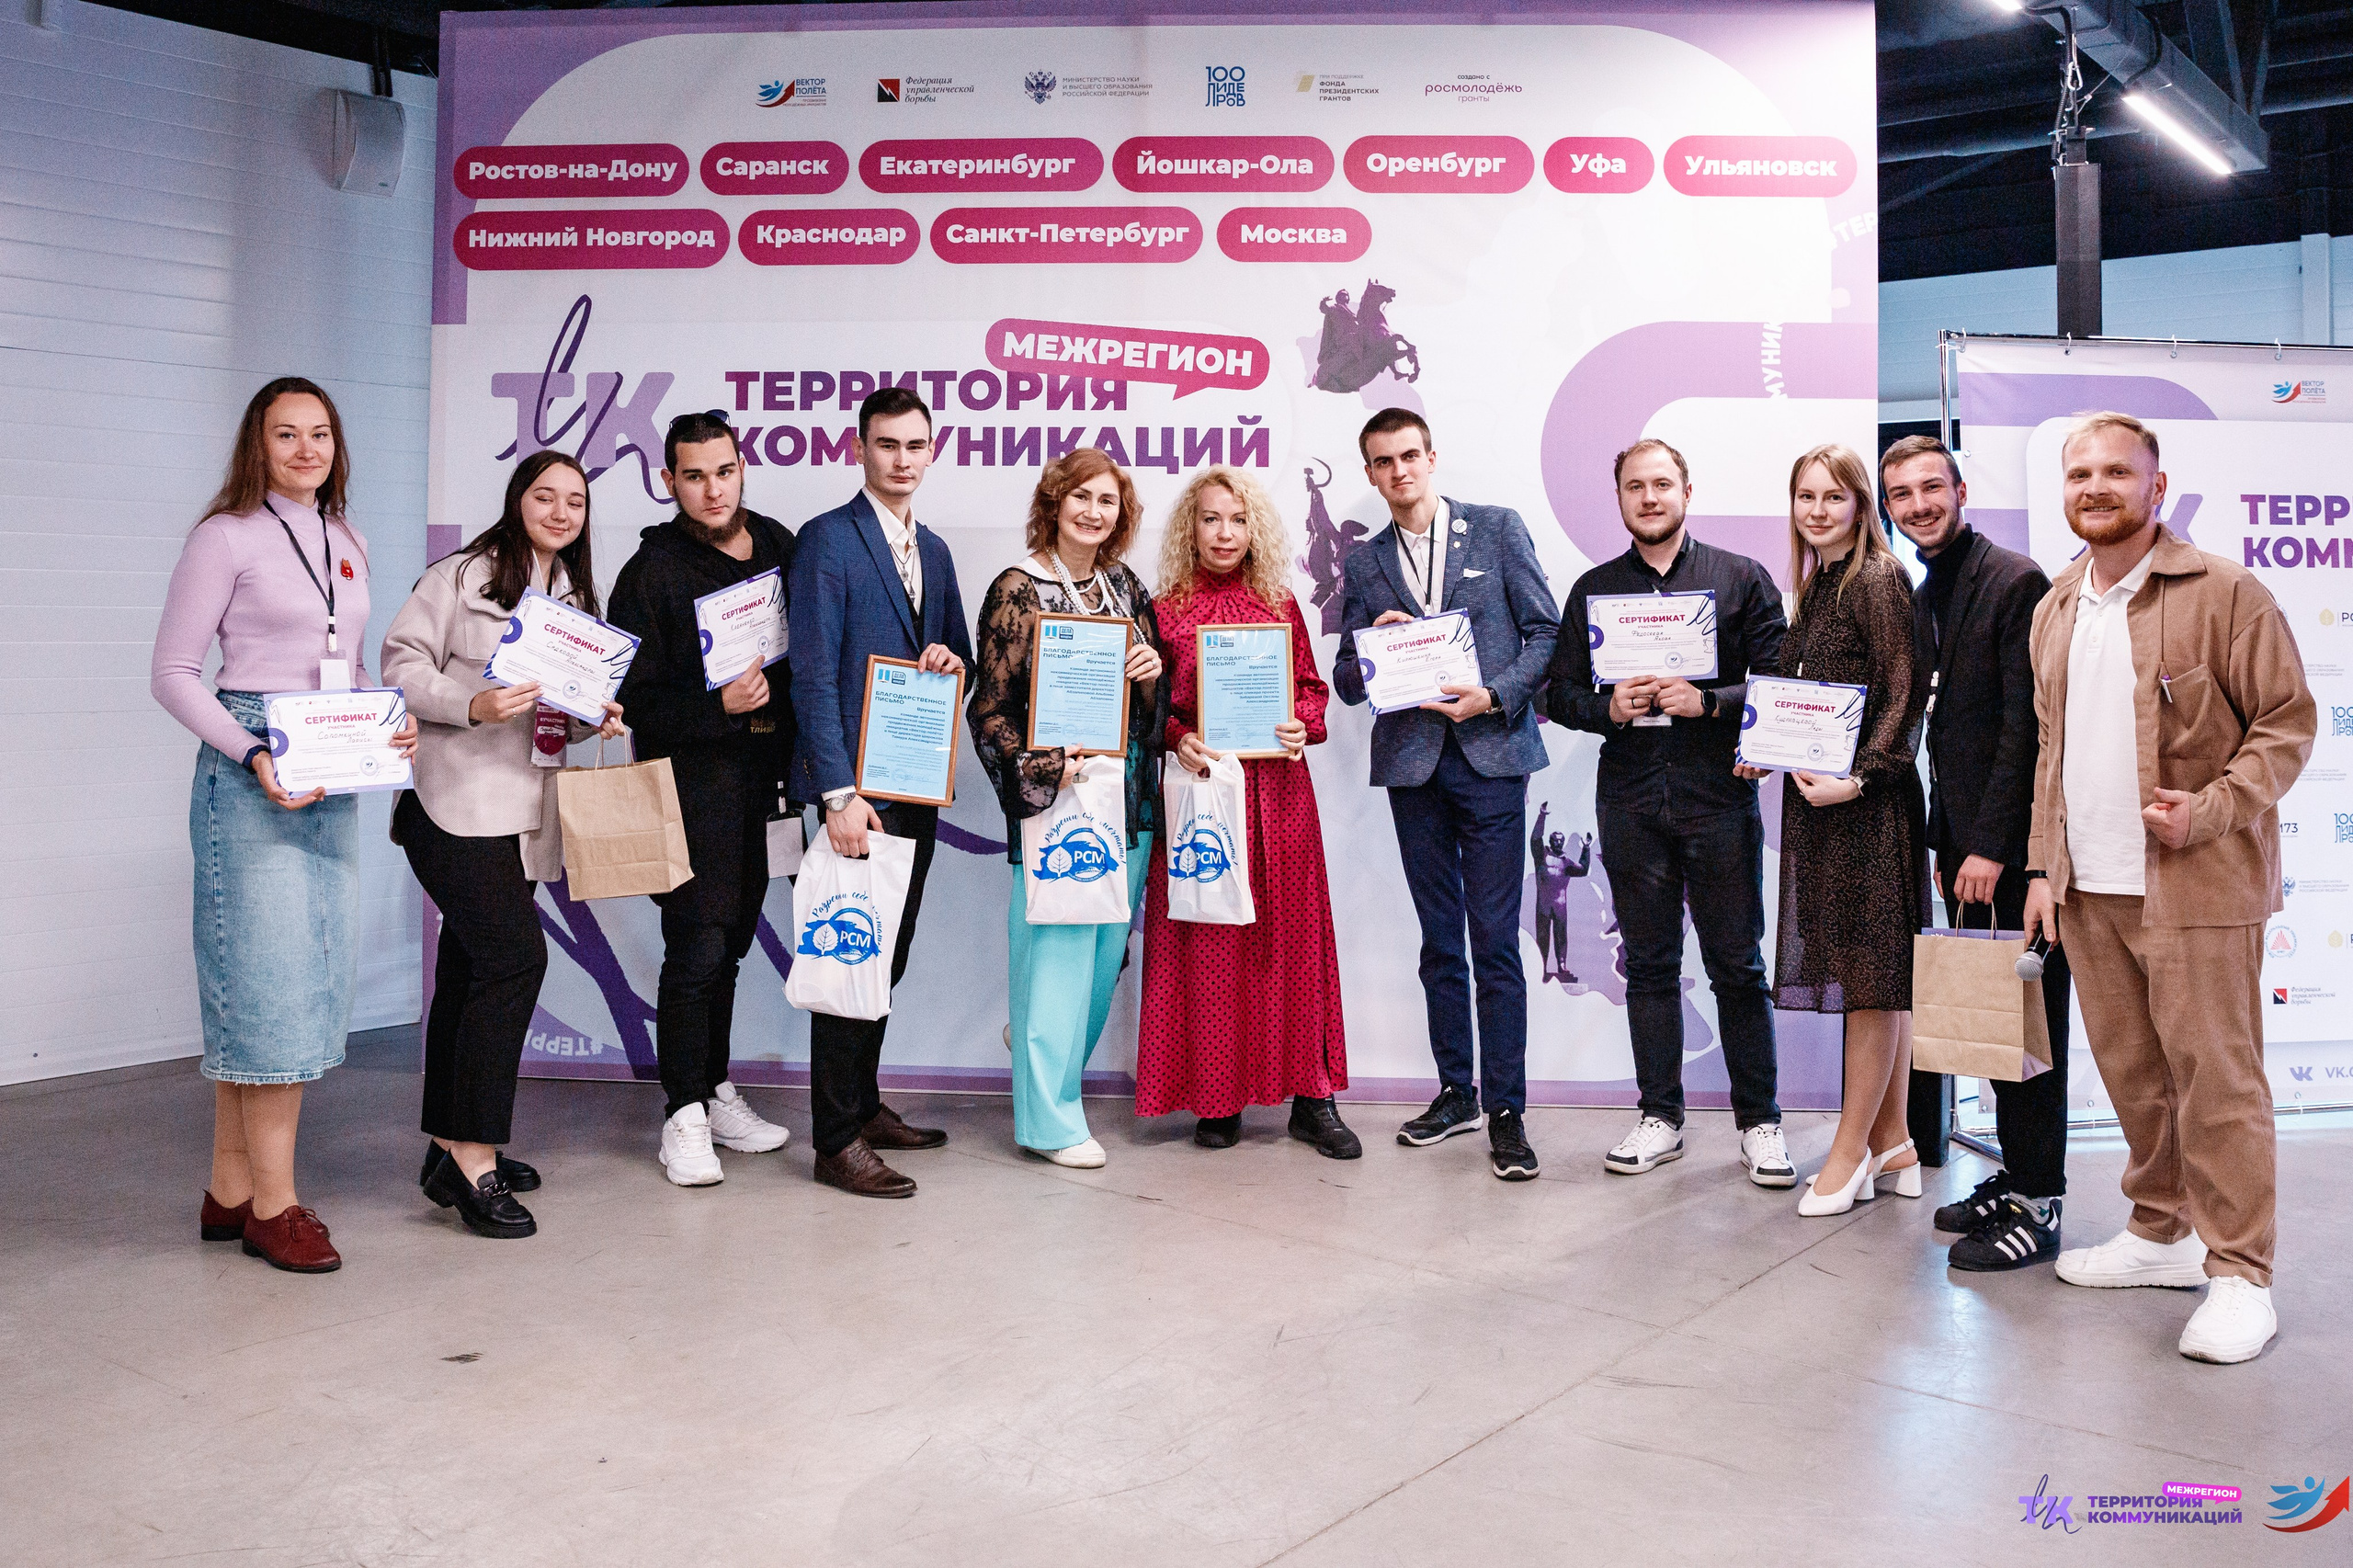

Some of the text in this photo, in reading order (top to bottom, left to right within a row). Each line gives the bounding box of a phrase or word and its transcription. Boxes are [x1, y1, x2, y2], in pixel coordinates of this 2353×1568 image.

[906, 77, 953, 85] Федерация
[1205, 66, 1245, 82] 100
[905, 93, 936, 103] борьбы
[906, 85, 974, 94] управленческой
[1426, 83, 1522, 97] росмолодёжь
[470, 160, 676, 182] Ростов-на-Дону
[716, 157, 828, 180] Саранск
[881, 153, 1075, 178] Екатеринбург
[1138, 151, 1313, 178] Йошкар-Ола
[1367, 152, 1506, 177] Оренбург
[1571, 153, 1626, 177] Уфа
[1686, 156, 1838, 176] Ульяновск
[470, 227, 715, 250] Нижний Новгород
[757, 225, 906, 247] Краснодар
[947, 222, 1189, 247] Санкт-Петербург
[1242, 224, 1347, 244] Москва
[1003, 331, 1253, 377] МЕЖРЕГИОН
[2244, 536, 2353, 568] КОМ
[722, 597, 766, 620] СЕРТИФИКАТ
[1619, 614, 1685, 624] СЕРТИФИКАТ
[544, 623, 606, 656] СЕРТИФИКАТ
[1387, 634, 1447, 652] СЕРТИФИКАТ
[875, 691, 946, 706] БЛАГОДАРСТВЕННОЕ
[875, 696, 904, 704] ПИСЬМО
[1775, 700, 1836, 713] СЕРТИФИКАТ
[305, 713, 377, 725] СЕРТИФИКАТ
[1074, 851, 1105, 864] РСМ
[840, 930, 872, 948] РСМ
